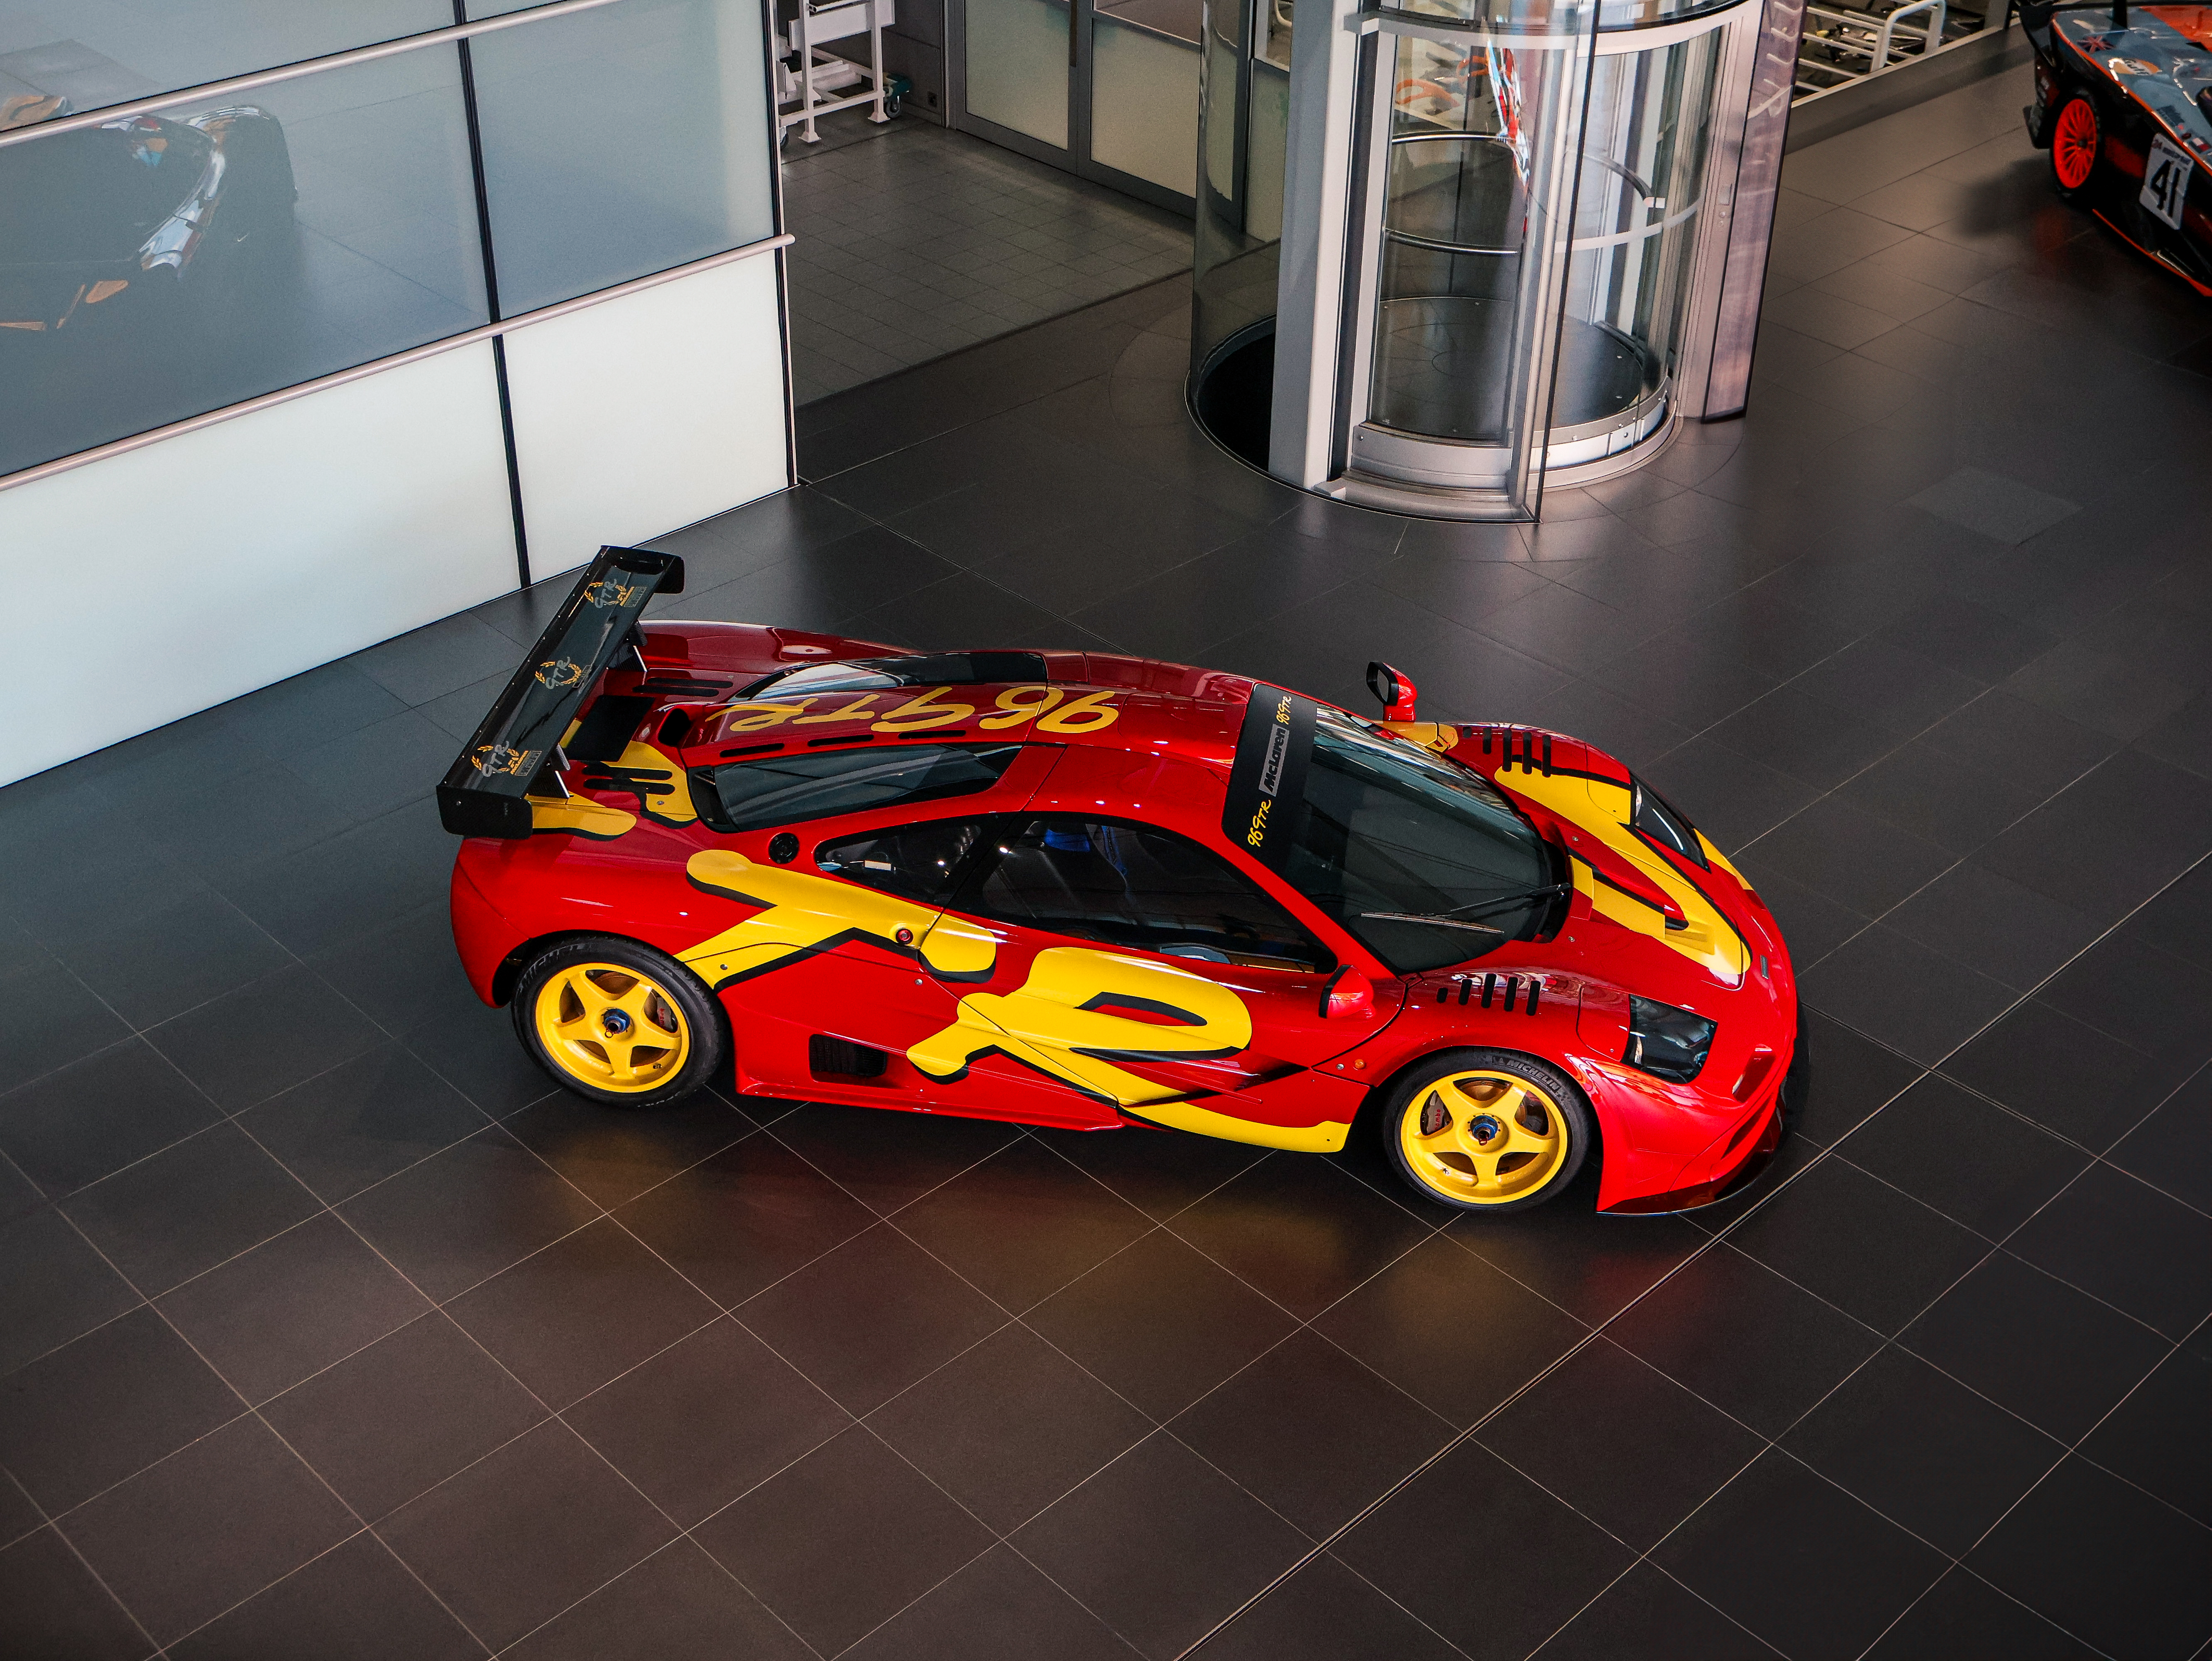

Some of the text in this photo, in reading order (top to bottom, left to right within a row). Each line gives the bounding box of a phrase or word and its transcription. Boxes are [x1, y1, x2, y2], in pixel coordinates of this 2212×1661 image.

[2149, 159, 2181, 218] 41
[1264, 728, 1286, 793] McLaren
[1506, 1060, 1561, 1090] MICHELIN
